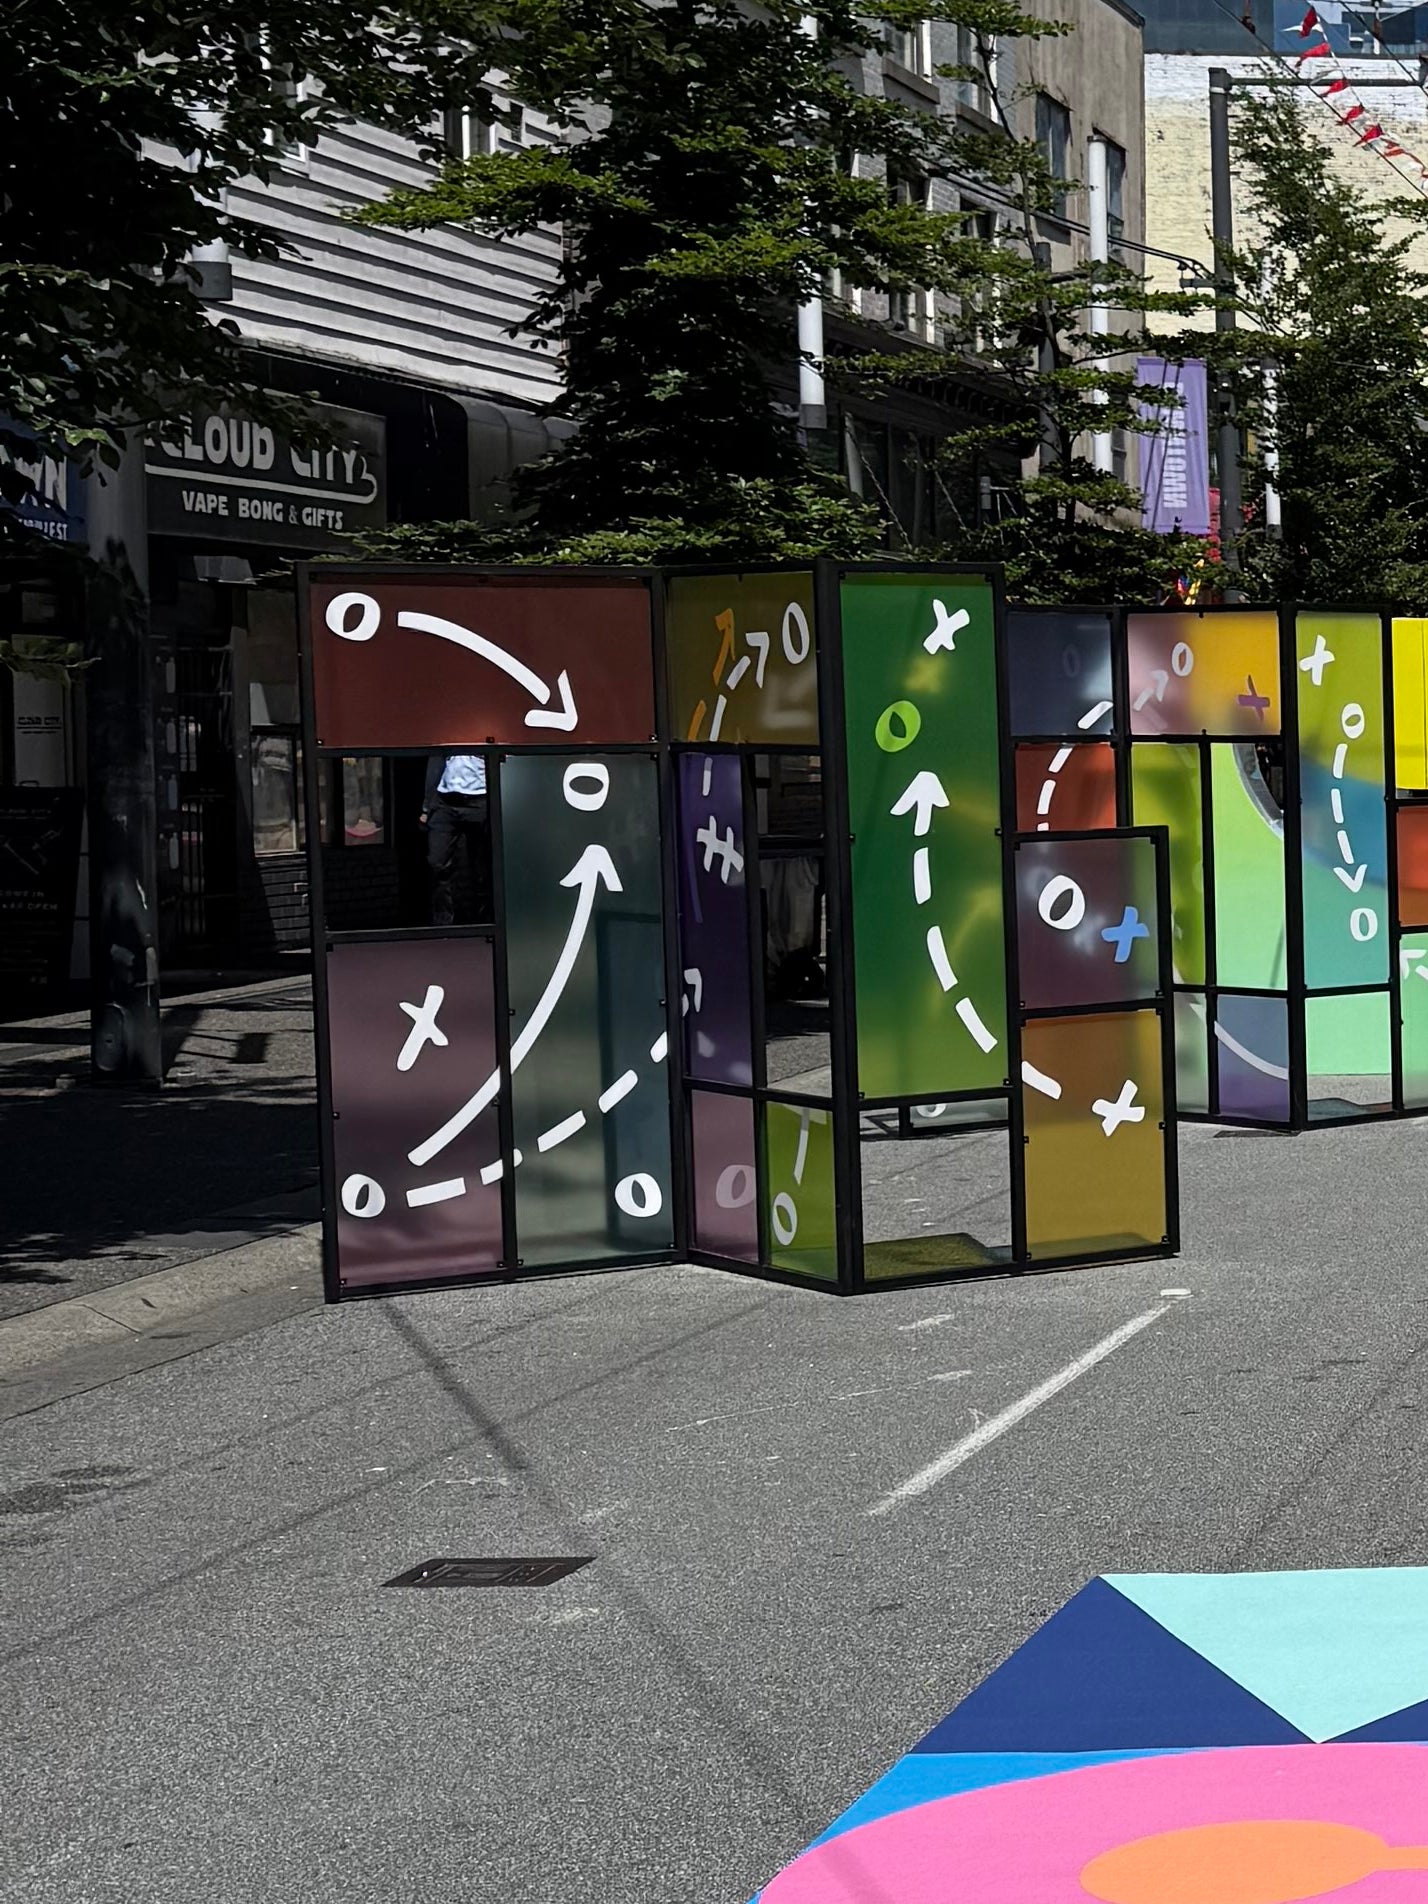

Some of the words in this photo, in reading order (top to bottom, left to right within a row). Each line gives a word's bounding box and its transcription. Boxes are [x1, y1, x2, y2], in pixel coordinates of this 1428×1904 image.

[181, 489, 229, 517] VAPE
[238, 497, 283, 523] BONG
[288, 504, 300, 526] &
[302, 506, 344, 531] GIFTS
